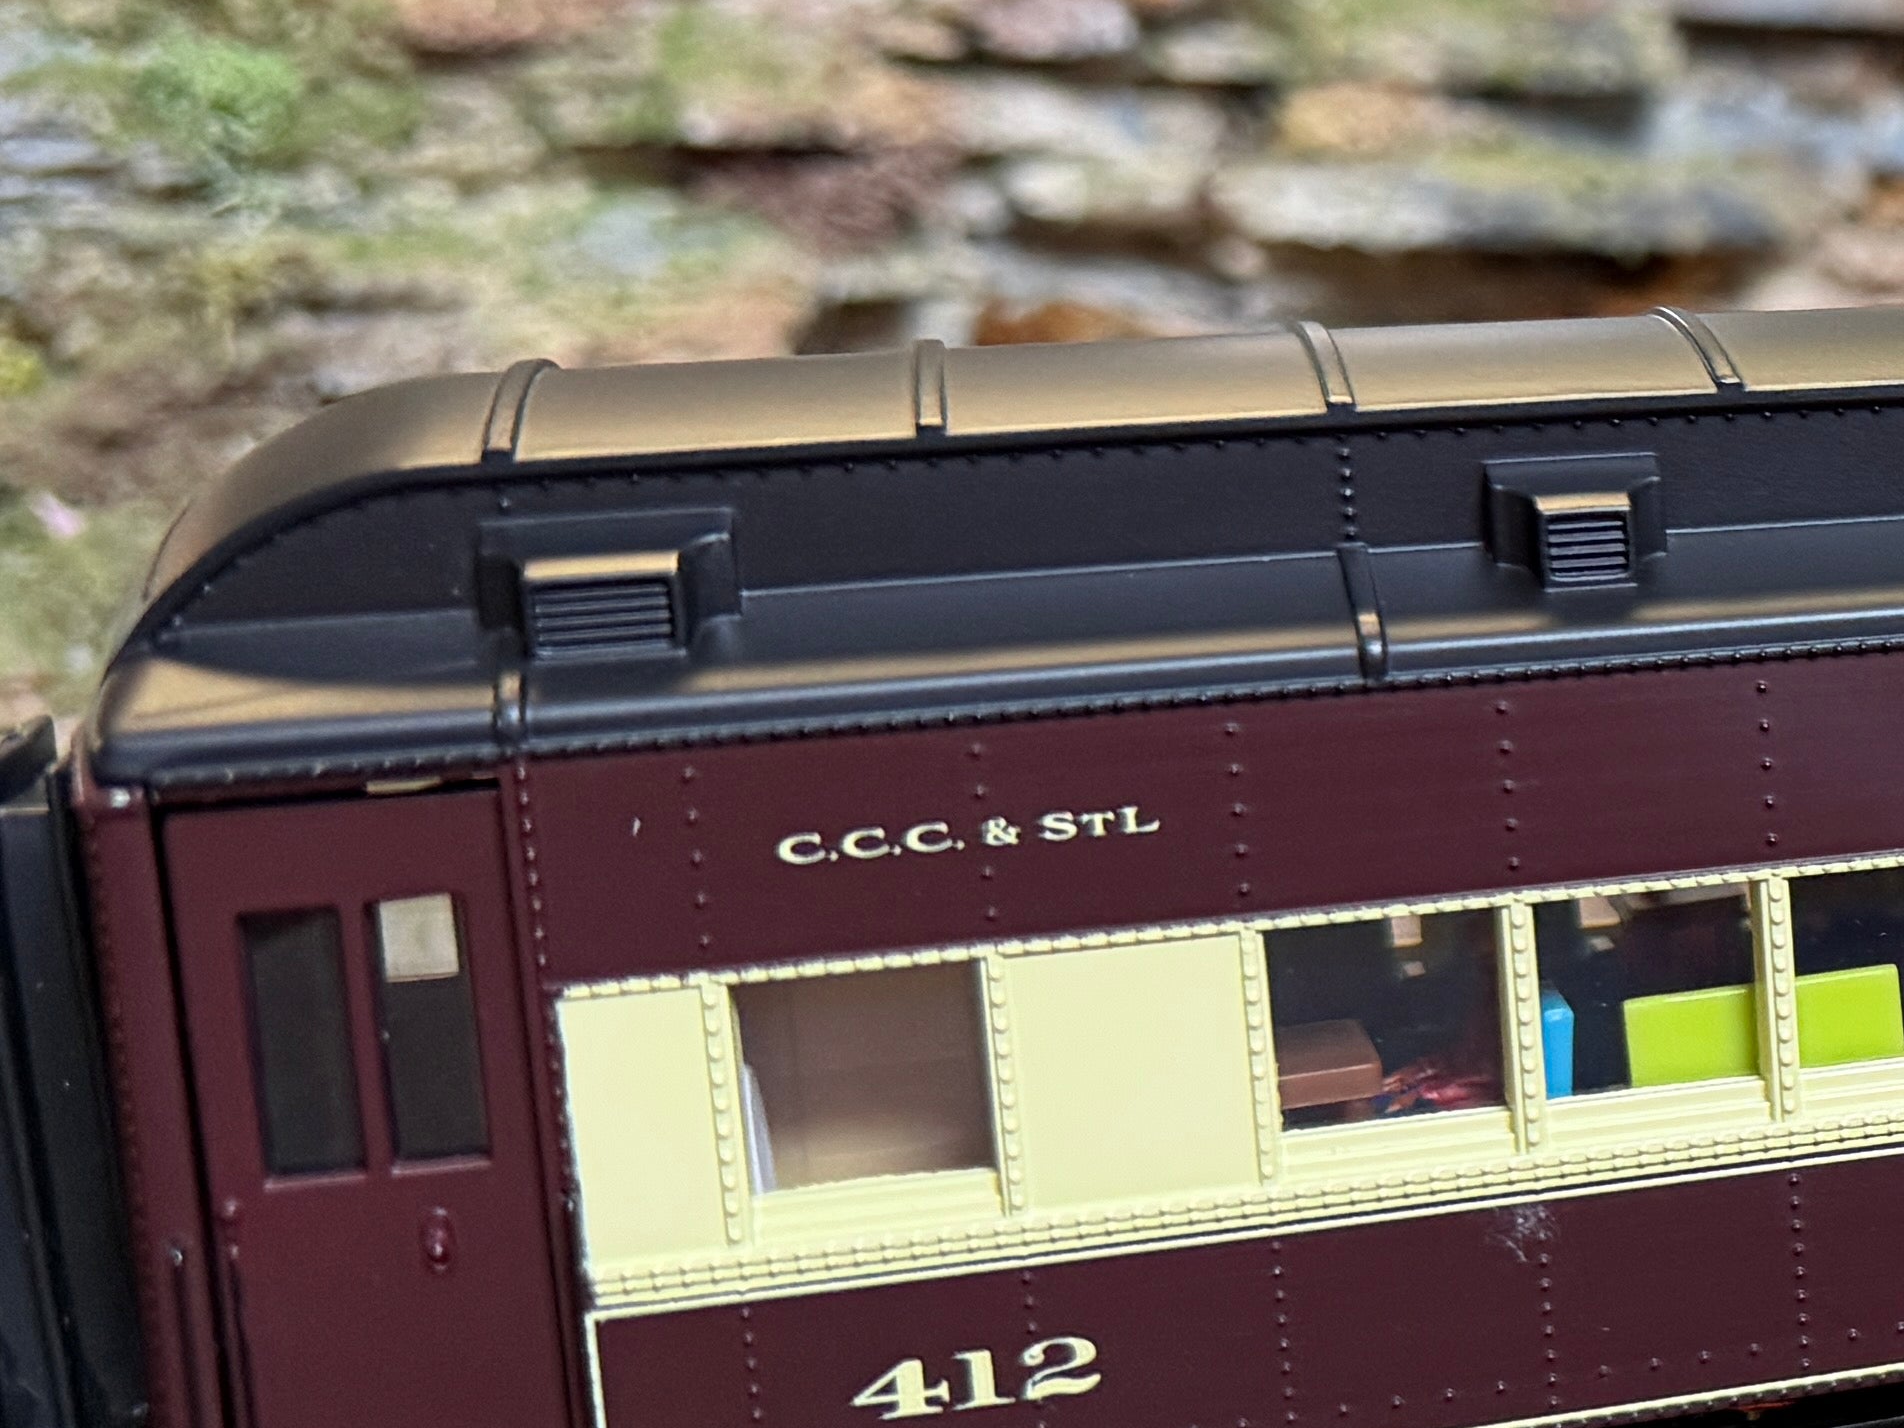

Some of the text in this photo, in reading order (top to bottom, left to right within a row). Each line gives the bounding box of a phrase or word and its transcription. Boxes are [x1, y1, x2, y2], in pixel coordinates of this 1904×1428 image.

[776, 821, 965, 865] C.C.C.
[981, 816, 1021, 847] &
[850, 1336, 1102, 1420] 412
